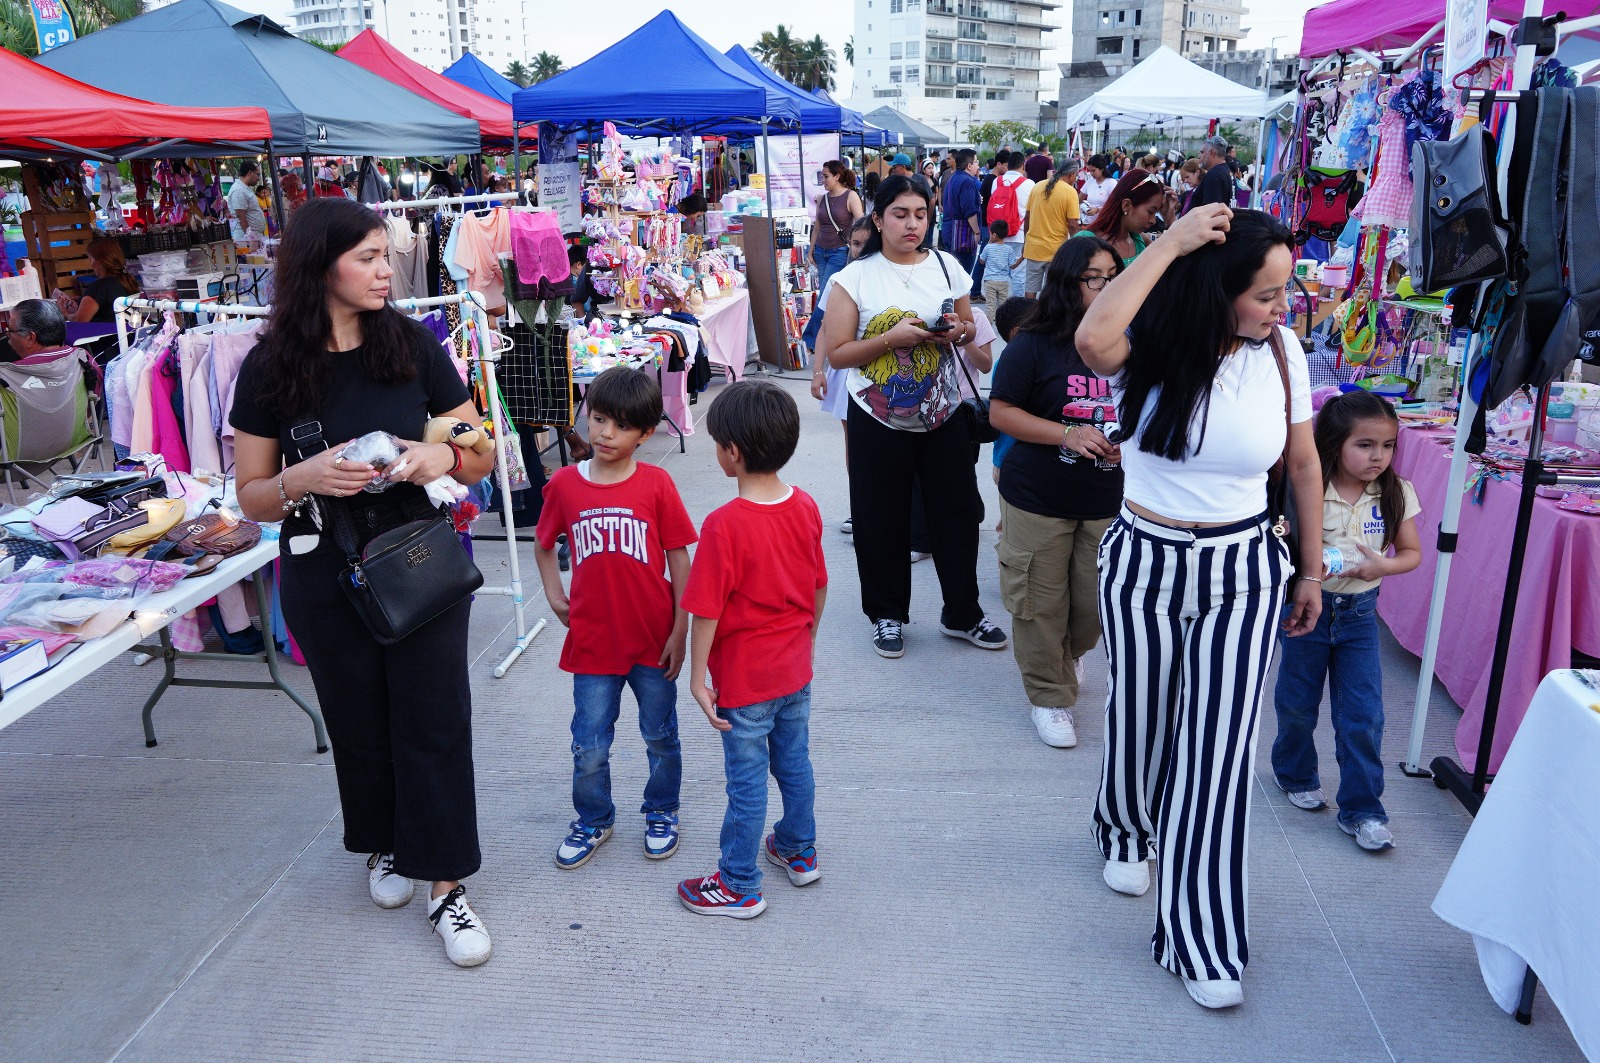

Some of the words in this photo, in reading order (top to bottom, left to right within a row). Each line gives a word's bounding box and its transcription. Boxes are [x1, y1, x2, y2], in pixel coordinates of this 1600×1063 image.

[1066, 374, 1112, 398] SU
[603, 507, 634, 516] CHAMPIONS
[1364, 521, 1386, 529] UNIC
[571, 516, 649, 567] BOSTON
